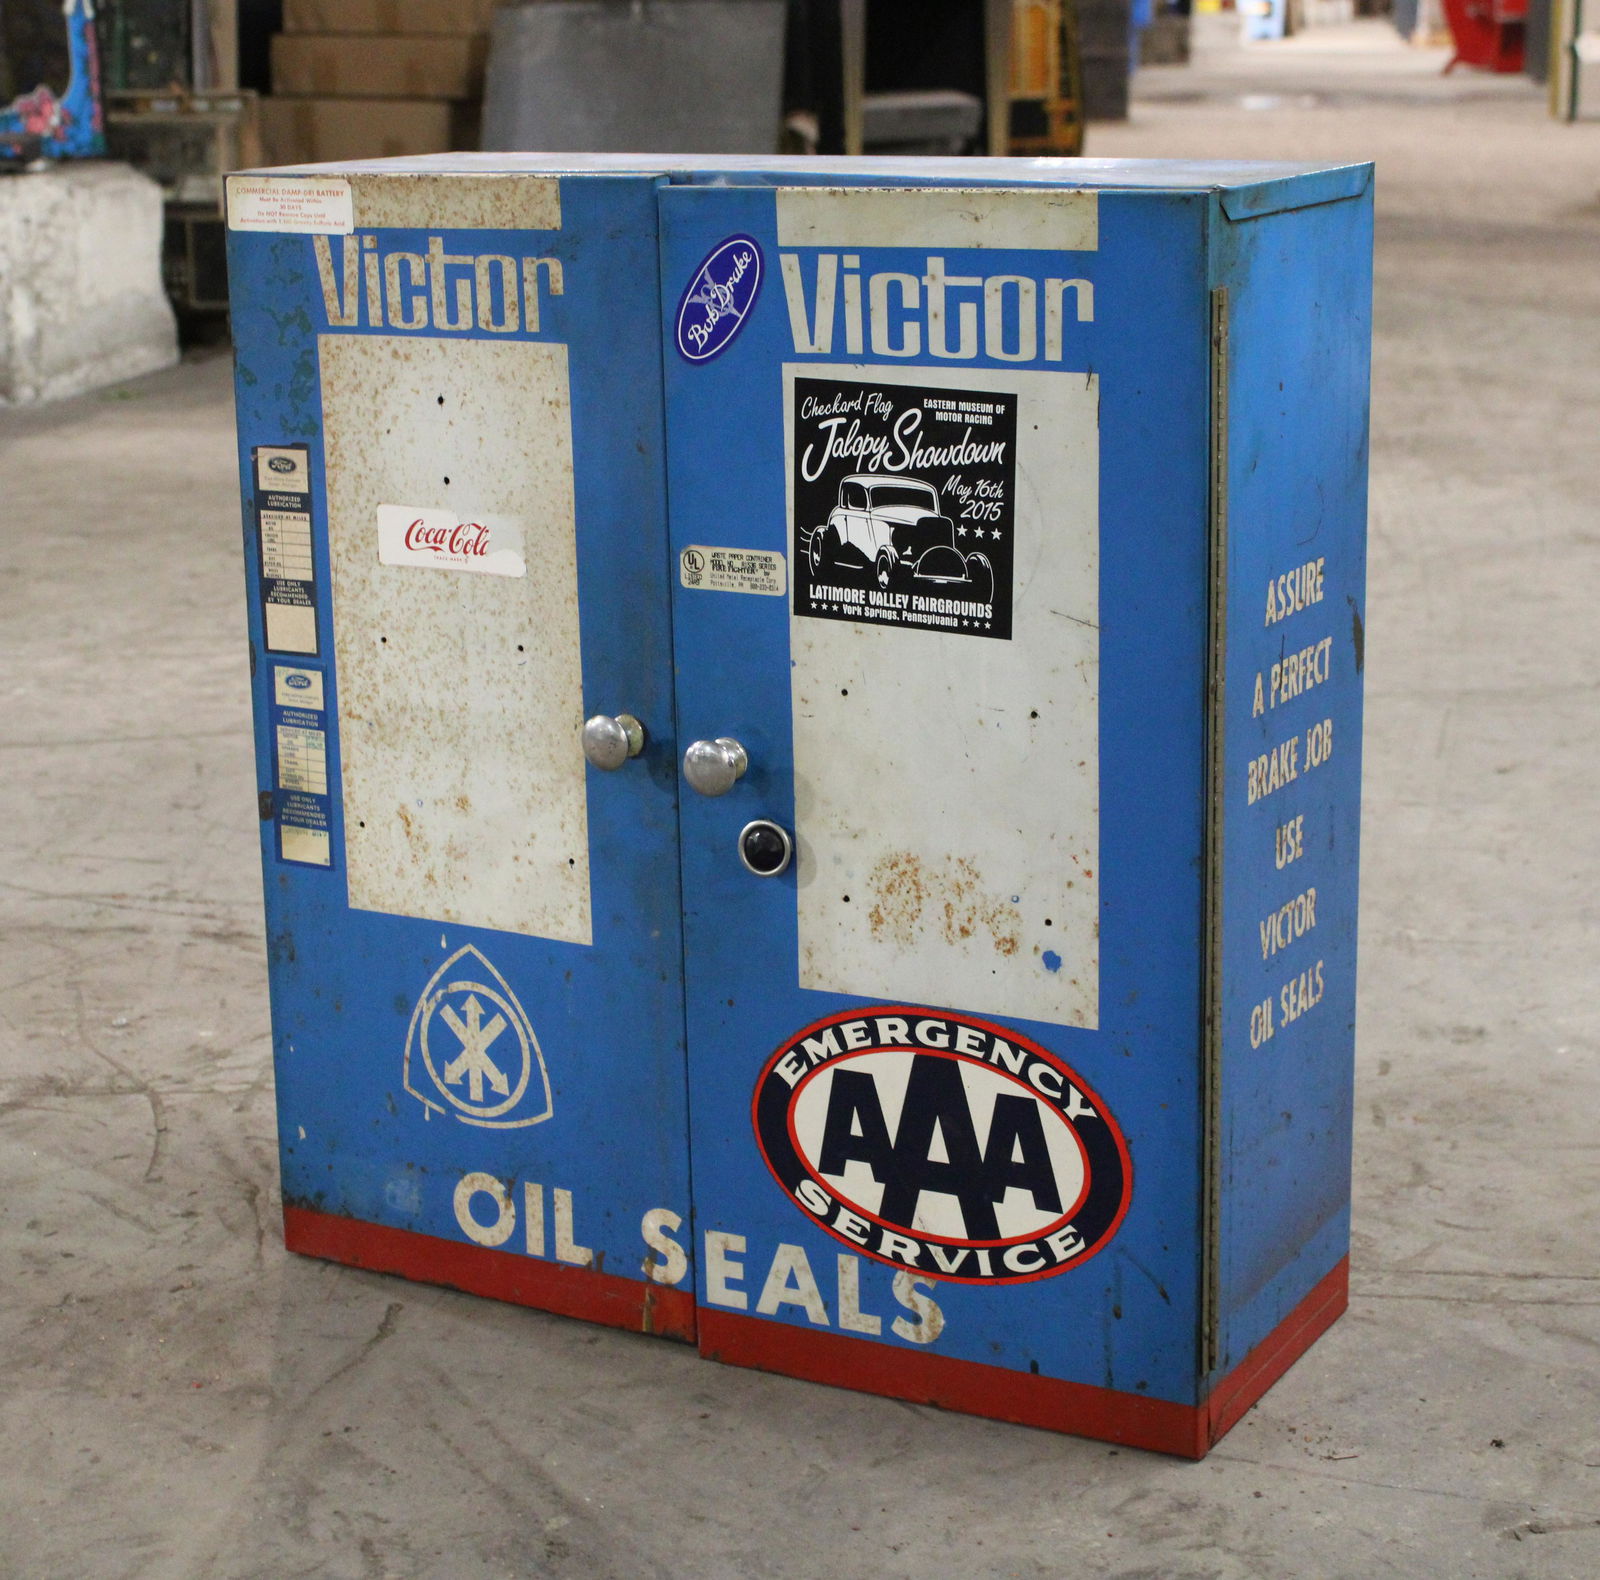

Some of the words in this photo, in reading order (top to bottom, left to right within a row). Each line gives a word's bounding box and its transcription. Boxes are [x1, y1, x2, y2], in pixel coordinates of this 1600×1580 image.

[312, 234, 564, 333] Victor
[688, 304, 720, 354] Bob
[710, 251, 752, 312] Drake
[779, 253, 1094, 362] Victor
[801, 390, 863, 420] Checkard
[863, 392, 894, 421] Flag
[923, 398, 957, 411] EASTERN
[958, 402, 994, 414] MUSEUM
[995, 405, 1006, 415] OF
[935, 411, 963, 423] MOTOR
[964, 413, 993, 426] RACING
[801, 417, 890, 482] Jalopy
[882, 408, 1007, 471] Showdown
[268, 494, 301, 503] AUTHORIZED
[941, 474, 973, 503] May
[974, 478, 1005, 499] 16th
[960, 499, 1005, 521] 2015
[809, 584, 866, 605] LATIMORE
[869, 590, 910, 610] VALLEY
[912, 594, 993, 619] FAIRGROUNDS
[842, 604, 863, 617] York
[902, 610, 959, 628] Pennsylvania
[1264, 556, 1325, 628] ASSURE
[1252, 671, 1265, 718] A
[1269, 635, 1333, 710] PERFECT
[282, 710, 319, 721] AUTHORIZED
[282, 717, 319, 728] LUBRICATION
[1247, 736, 1299, 806] BRAKE
[1303, 718, 1333, 773] JOB
[1275, 814, 1304, 870] USE
[1259, 887, 1317, 961] VICTOR
[1250, 996, 1274, 1050] OIL
[1280, 959, 1324, 1028] SEALS
[773, 1016, 1098, 1123] EMERGENCY
[818, 1054, 1064, 1241] AAA
[453, 1171, 594, 1266] OIL
[794, 1178, 1087, 1277] SERVICE
